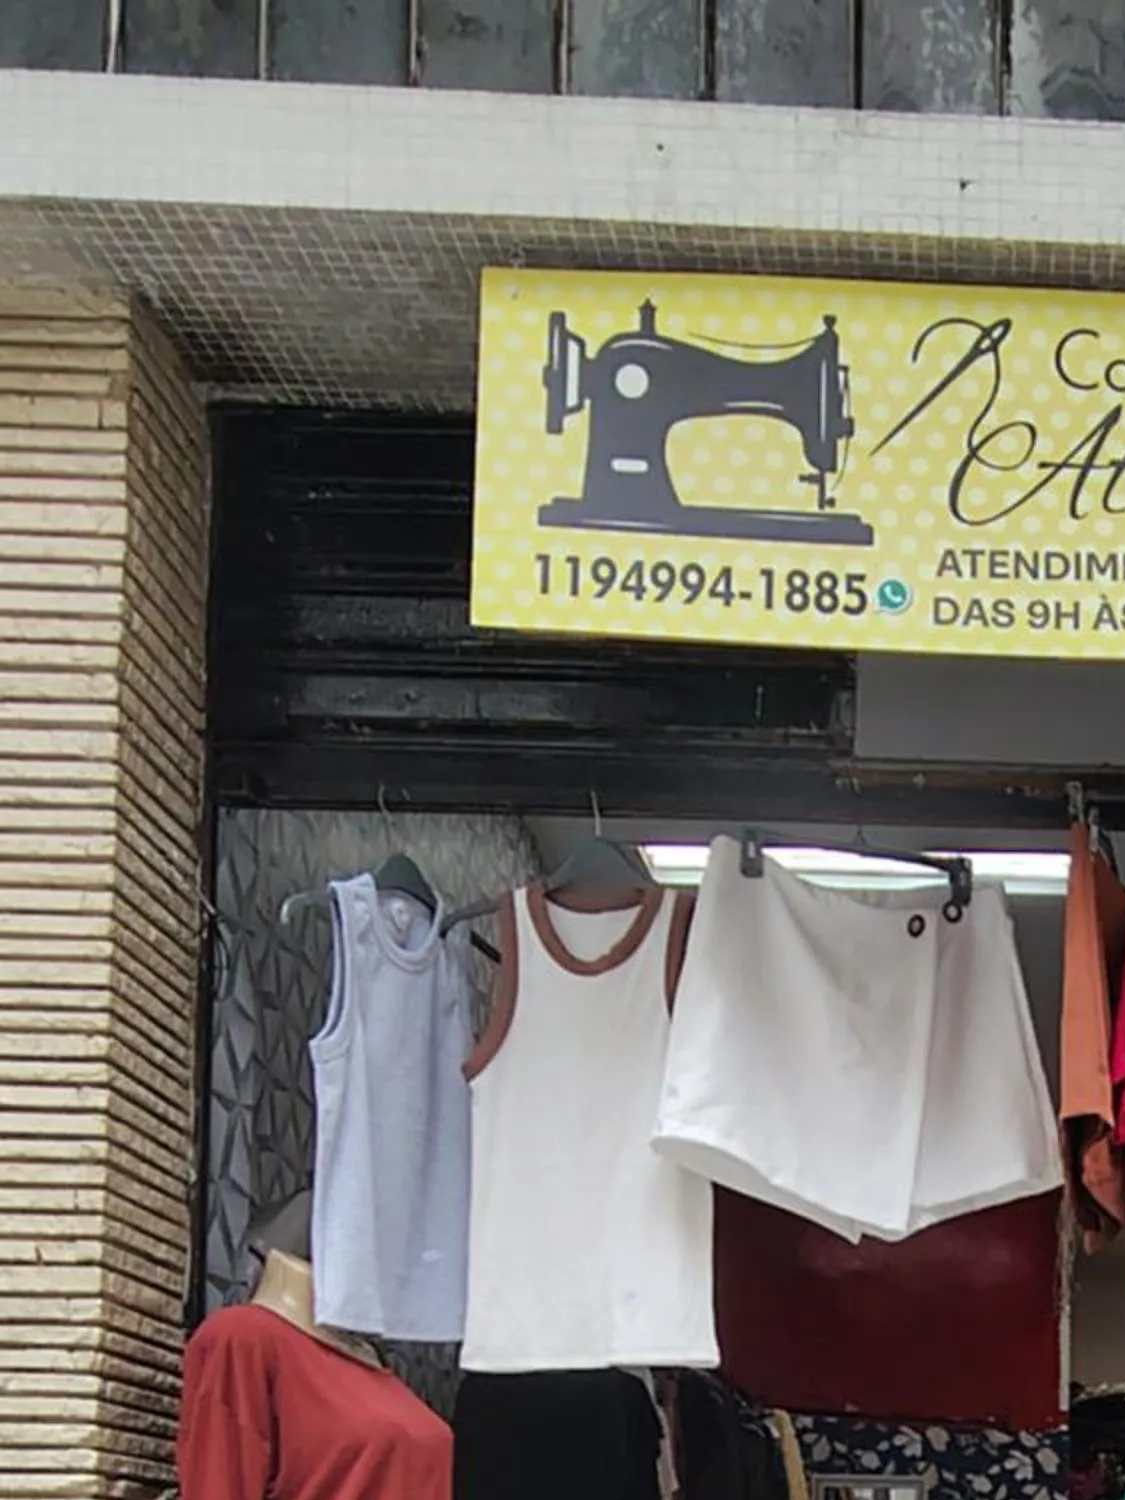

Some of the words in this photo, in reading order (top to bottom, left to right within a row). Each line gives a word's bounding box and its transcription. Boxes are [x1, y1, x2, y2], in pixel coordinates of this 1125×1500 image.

[536, 554, 868, 616] 1194994-1885
[934, 597, 1015, 629] DAS
[1027, 600, 1081, 631] 9H
